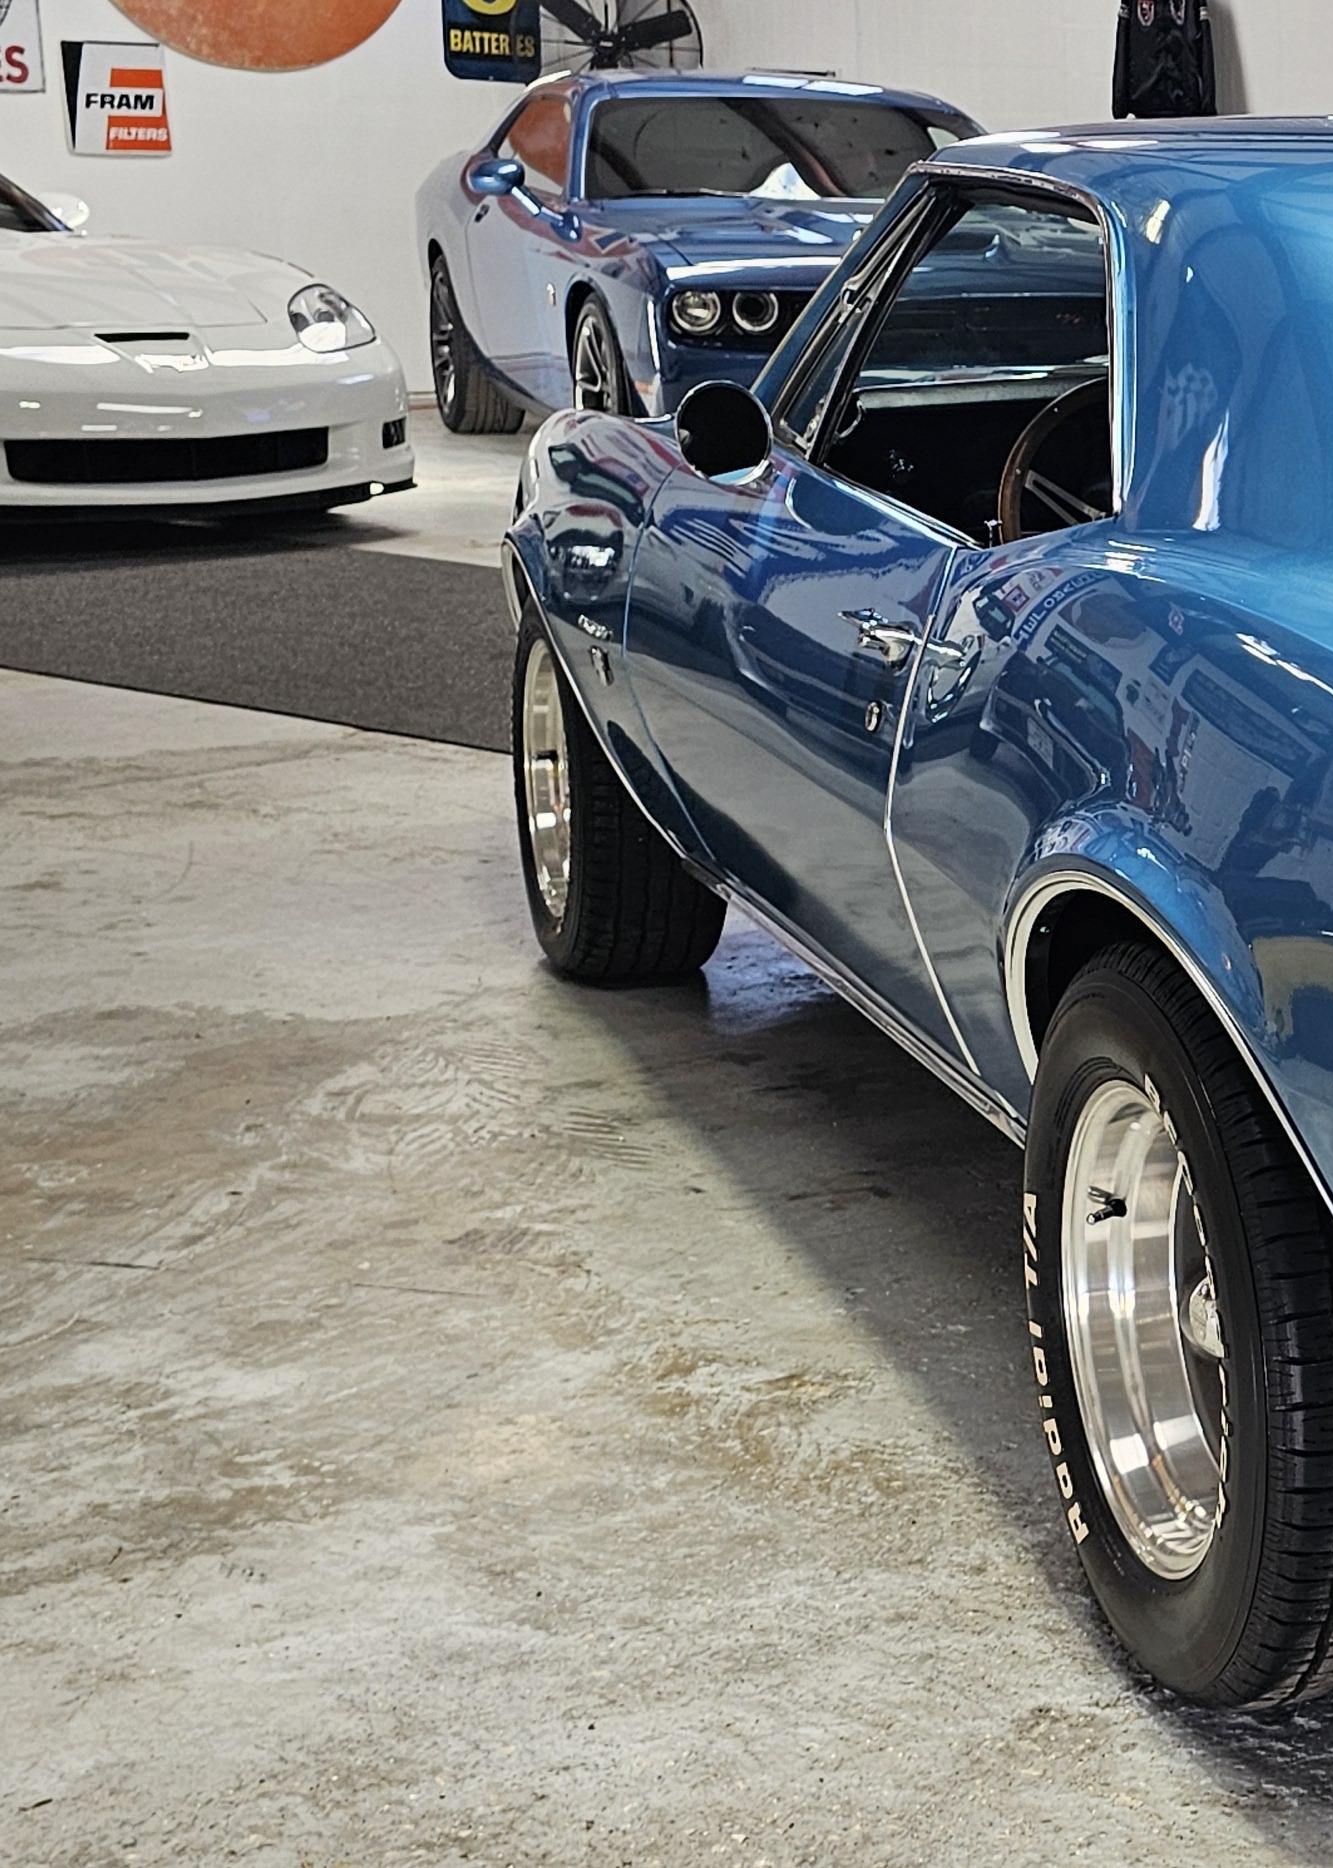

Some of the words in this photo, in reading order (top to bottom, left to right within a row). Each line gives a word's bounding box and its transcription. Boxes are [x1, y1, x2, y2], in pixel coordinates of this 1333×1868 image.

[450, 28, 535, 57] BATTERES
[85, 92, 155, 110] FRAM
[109, 126, 168, 141] FILTERS
[1023, 1192, 1039, 1290] T/A
[1028, 1319, 1090, 1545] Radial
